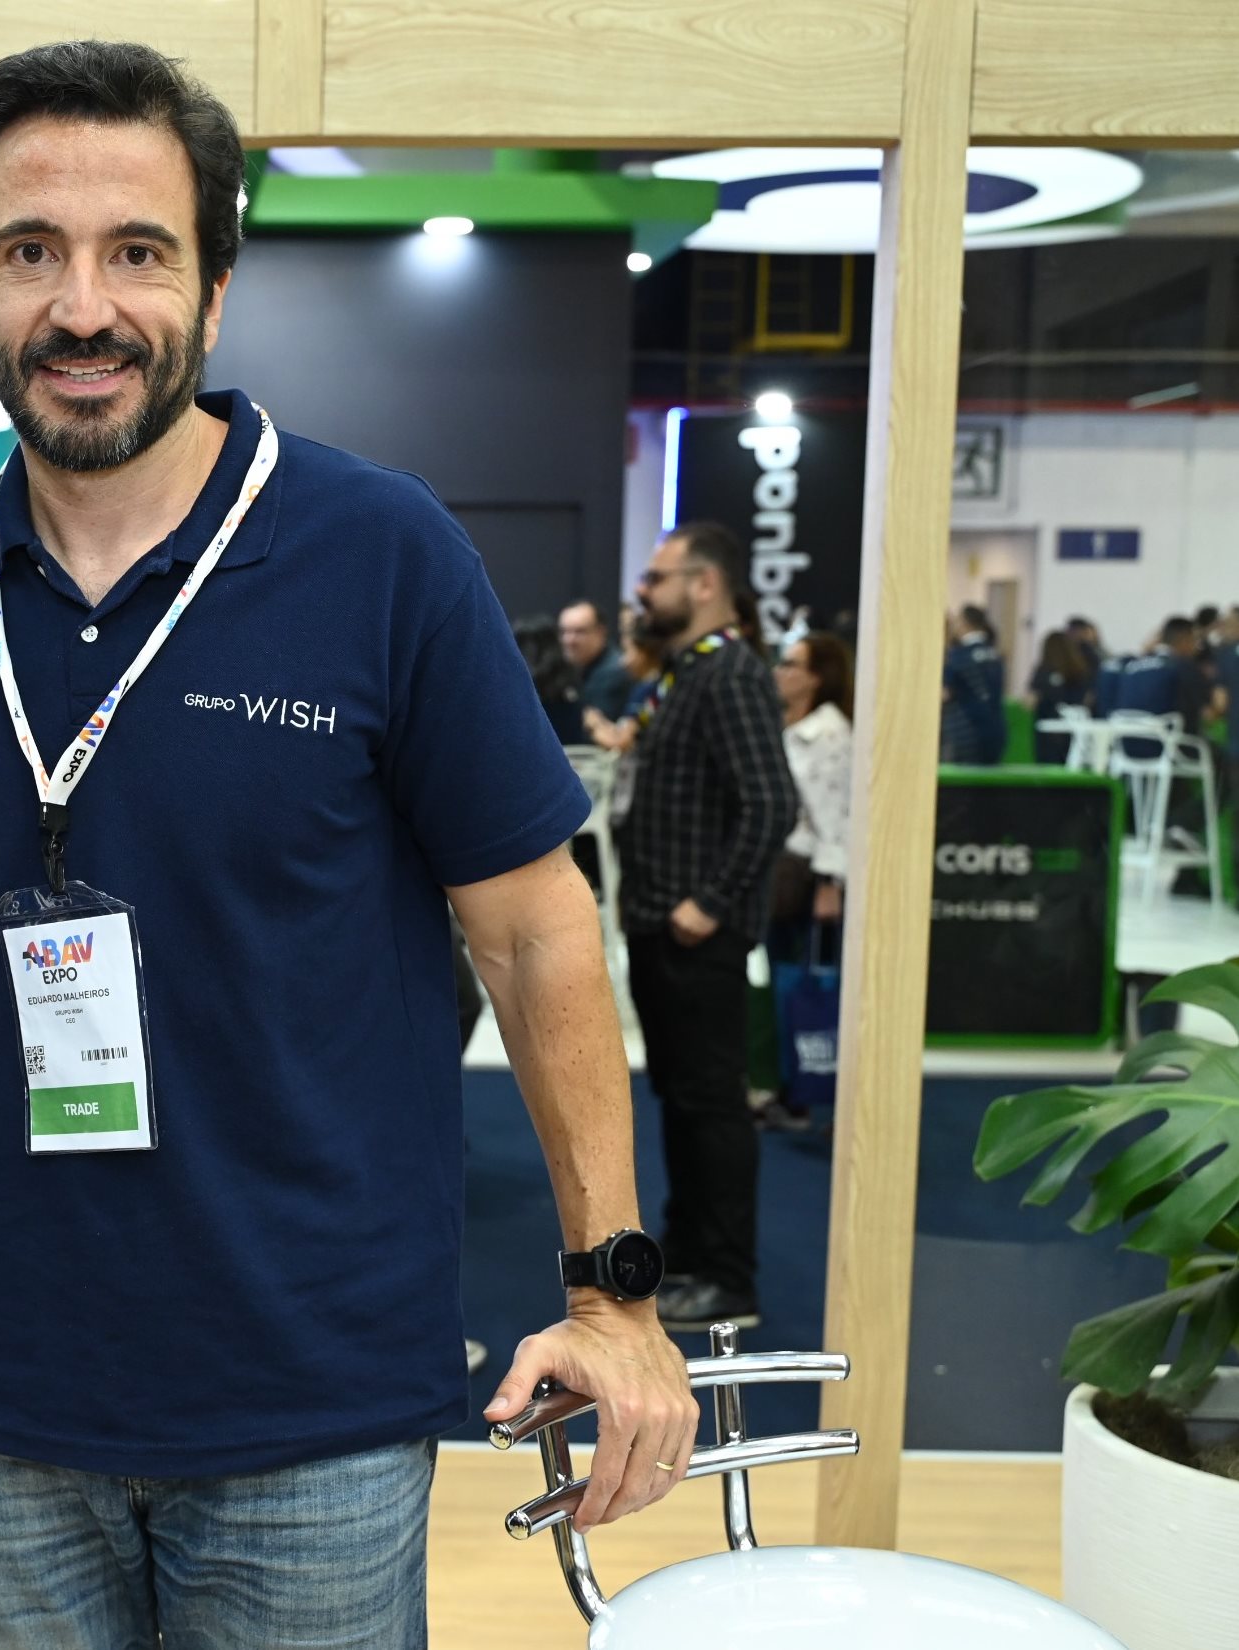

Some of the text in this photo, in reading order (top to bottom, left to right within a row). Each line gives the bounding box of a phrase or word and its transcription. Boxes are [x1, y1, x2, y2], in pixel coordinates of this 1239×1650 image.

[78, 682, 120, 748] BAV
[184, 693, 336, 733] GRUPO WISH
[63, 748, 87, 782] EXPO
[22, 931, 93, 971] ABAV
[42, 967, 77, 984] EXPO
[27, 988, 110, 1005] EDUARDO MALHEIROS
[63, 1102, 99, 1116] TRADE
